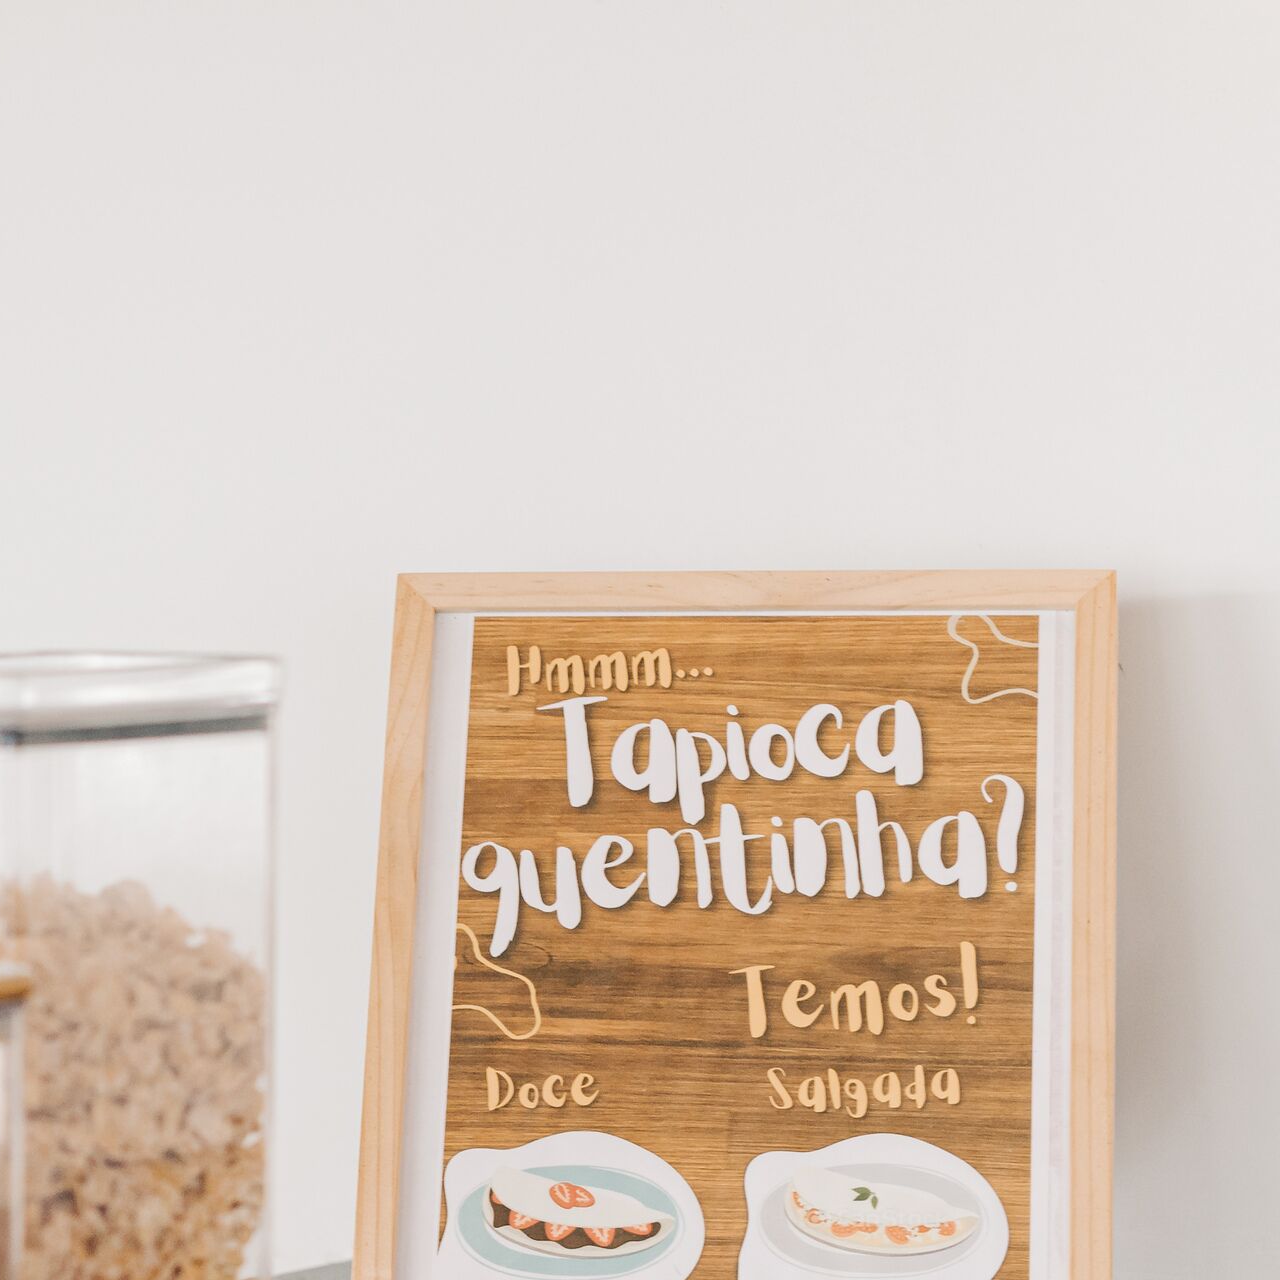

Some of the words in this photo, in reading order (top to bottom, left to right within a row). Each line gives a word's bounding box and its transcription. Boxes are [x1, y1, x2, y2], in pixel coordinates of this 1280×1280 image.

[505, 645, 714, 697] Hmmm...
[537, 695, 924, 825] Tapioca
[461, 774, 1025, 958] quentinha?
[728, 940, 980, 1038] Temos!
[485, 1066, 600, 1112] Doce
[767, 1064, 961, 1119] Salgada
